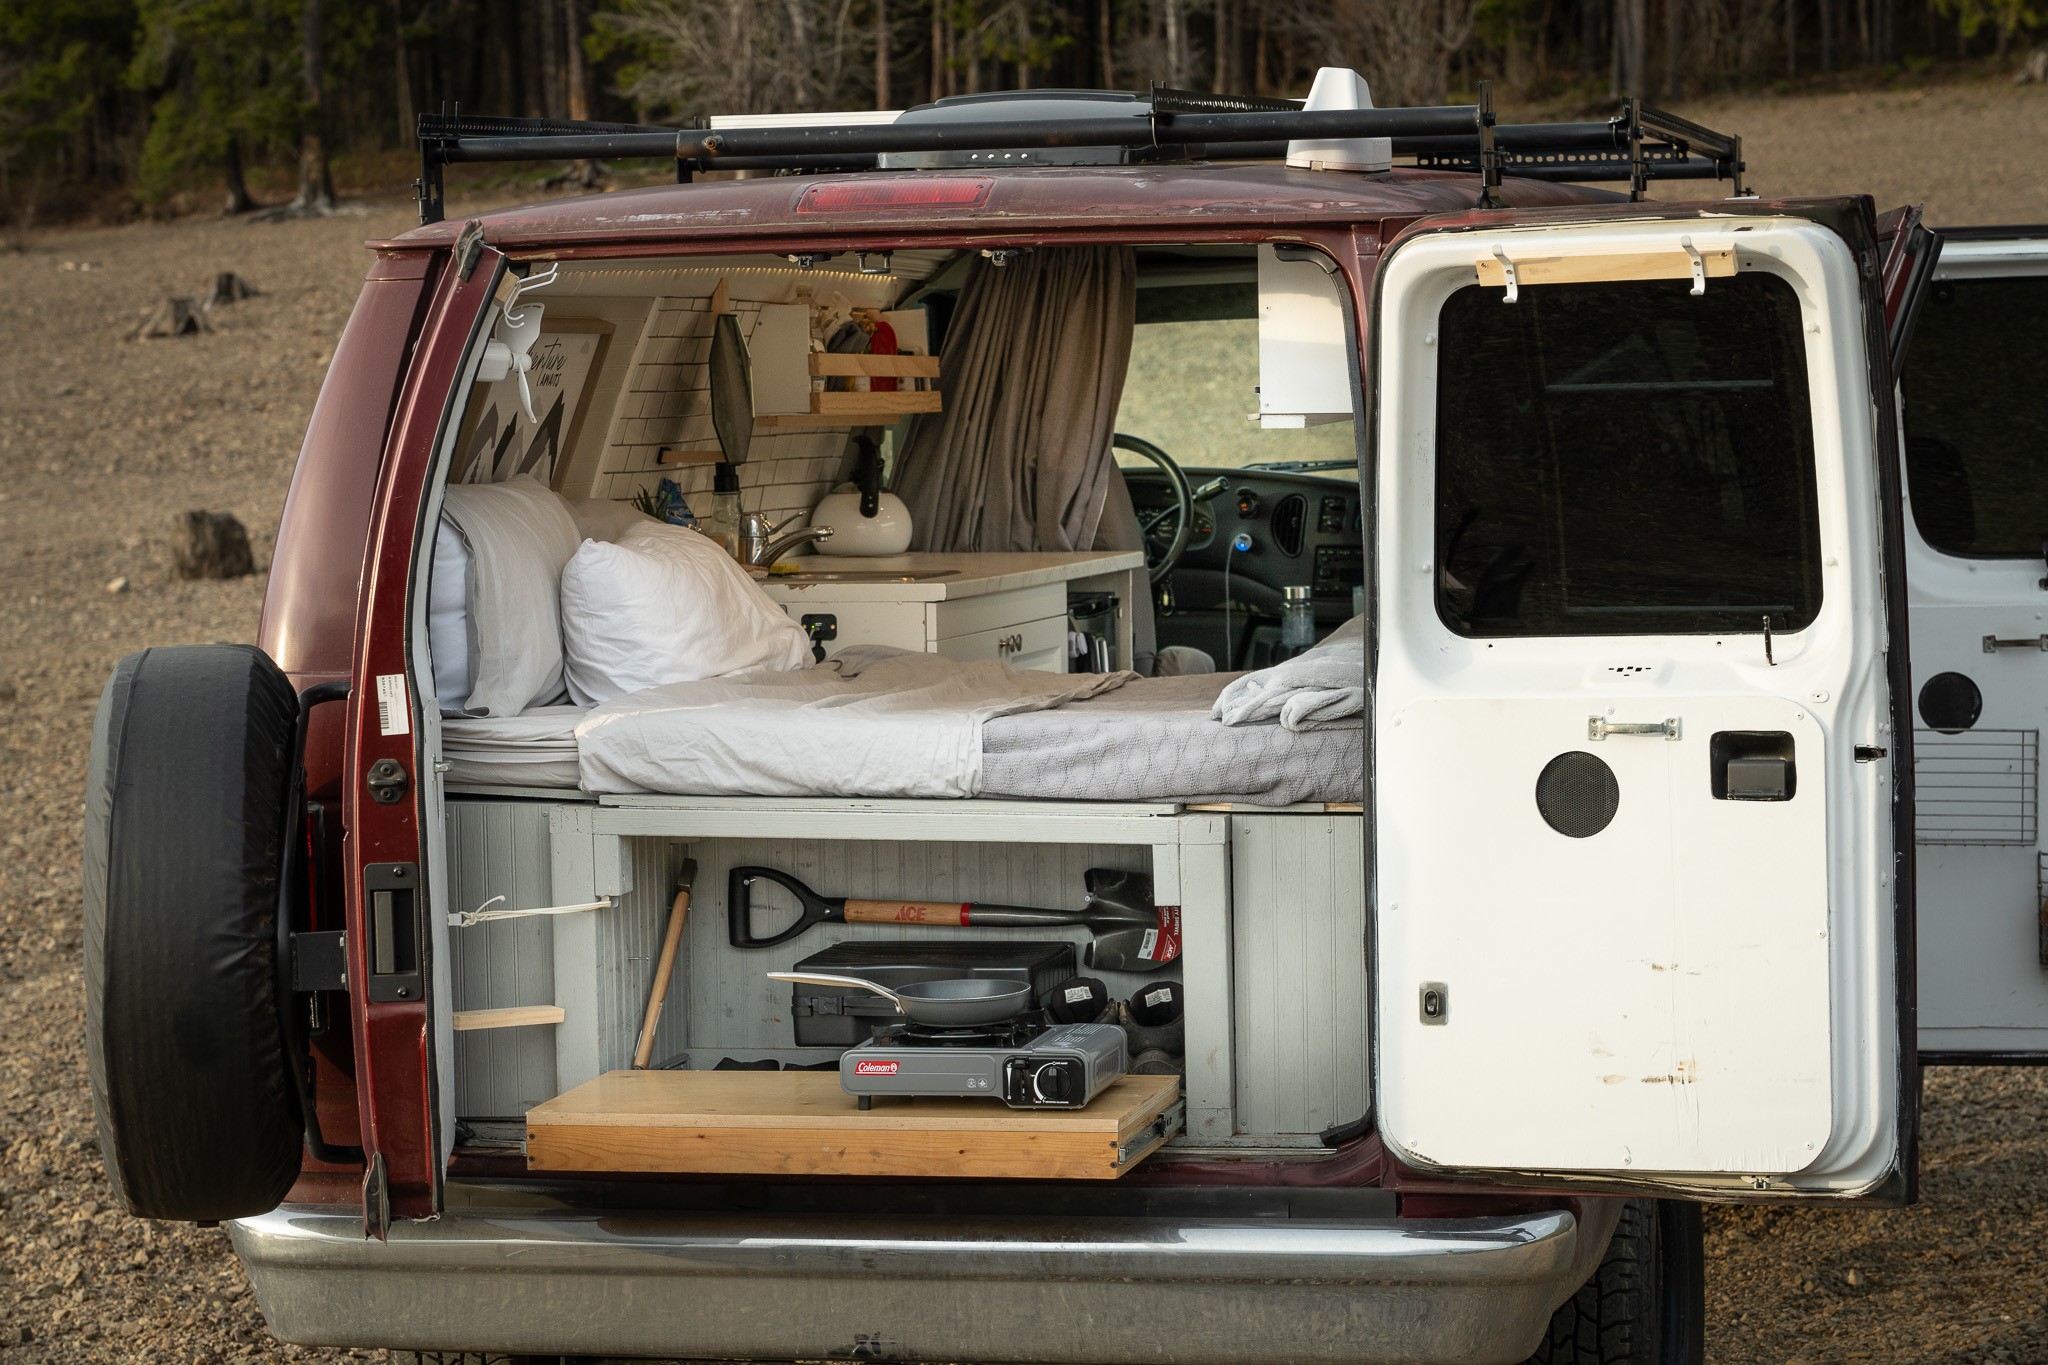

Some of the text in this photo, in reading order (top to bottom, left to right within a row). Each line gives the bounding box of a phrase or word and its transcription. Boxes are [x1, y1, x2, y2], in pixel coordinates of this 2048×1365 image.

[527, 337, 568, 372] enture
[895, 905, 927, 921] ACE
[858, 1062, 890, 1072] Coleman
